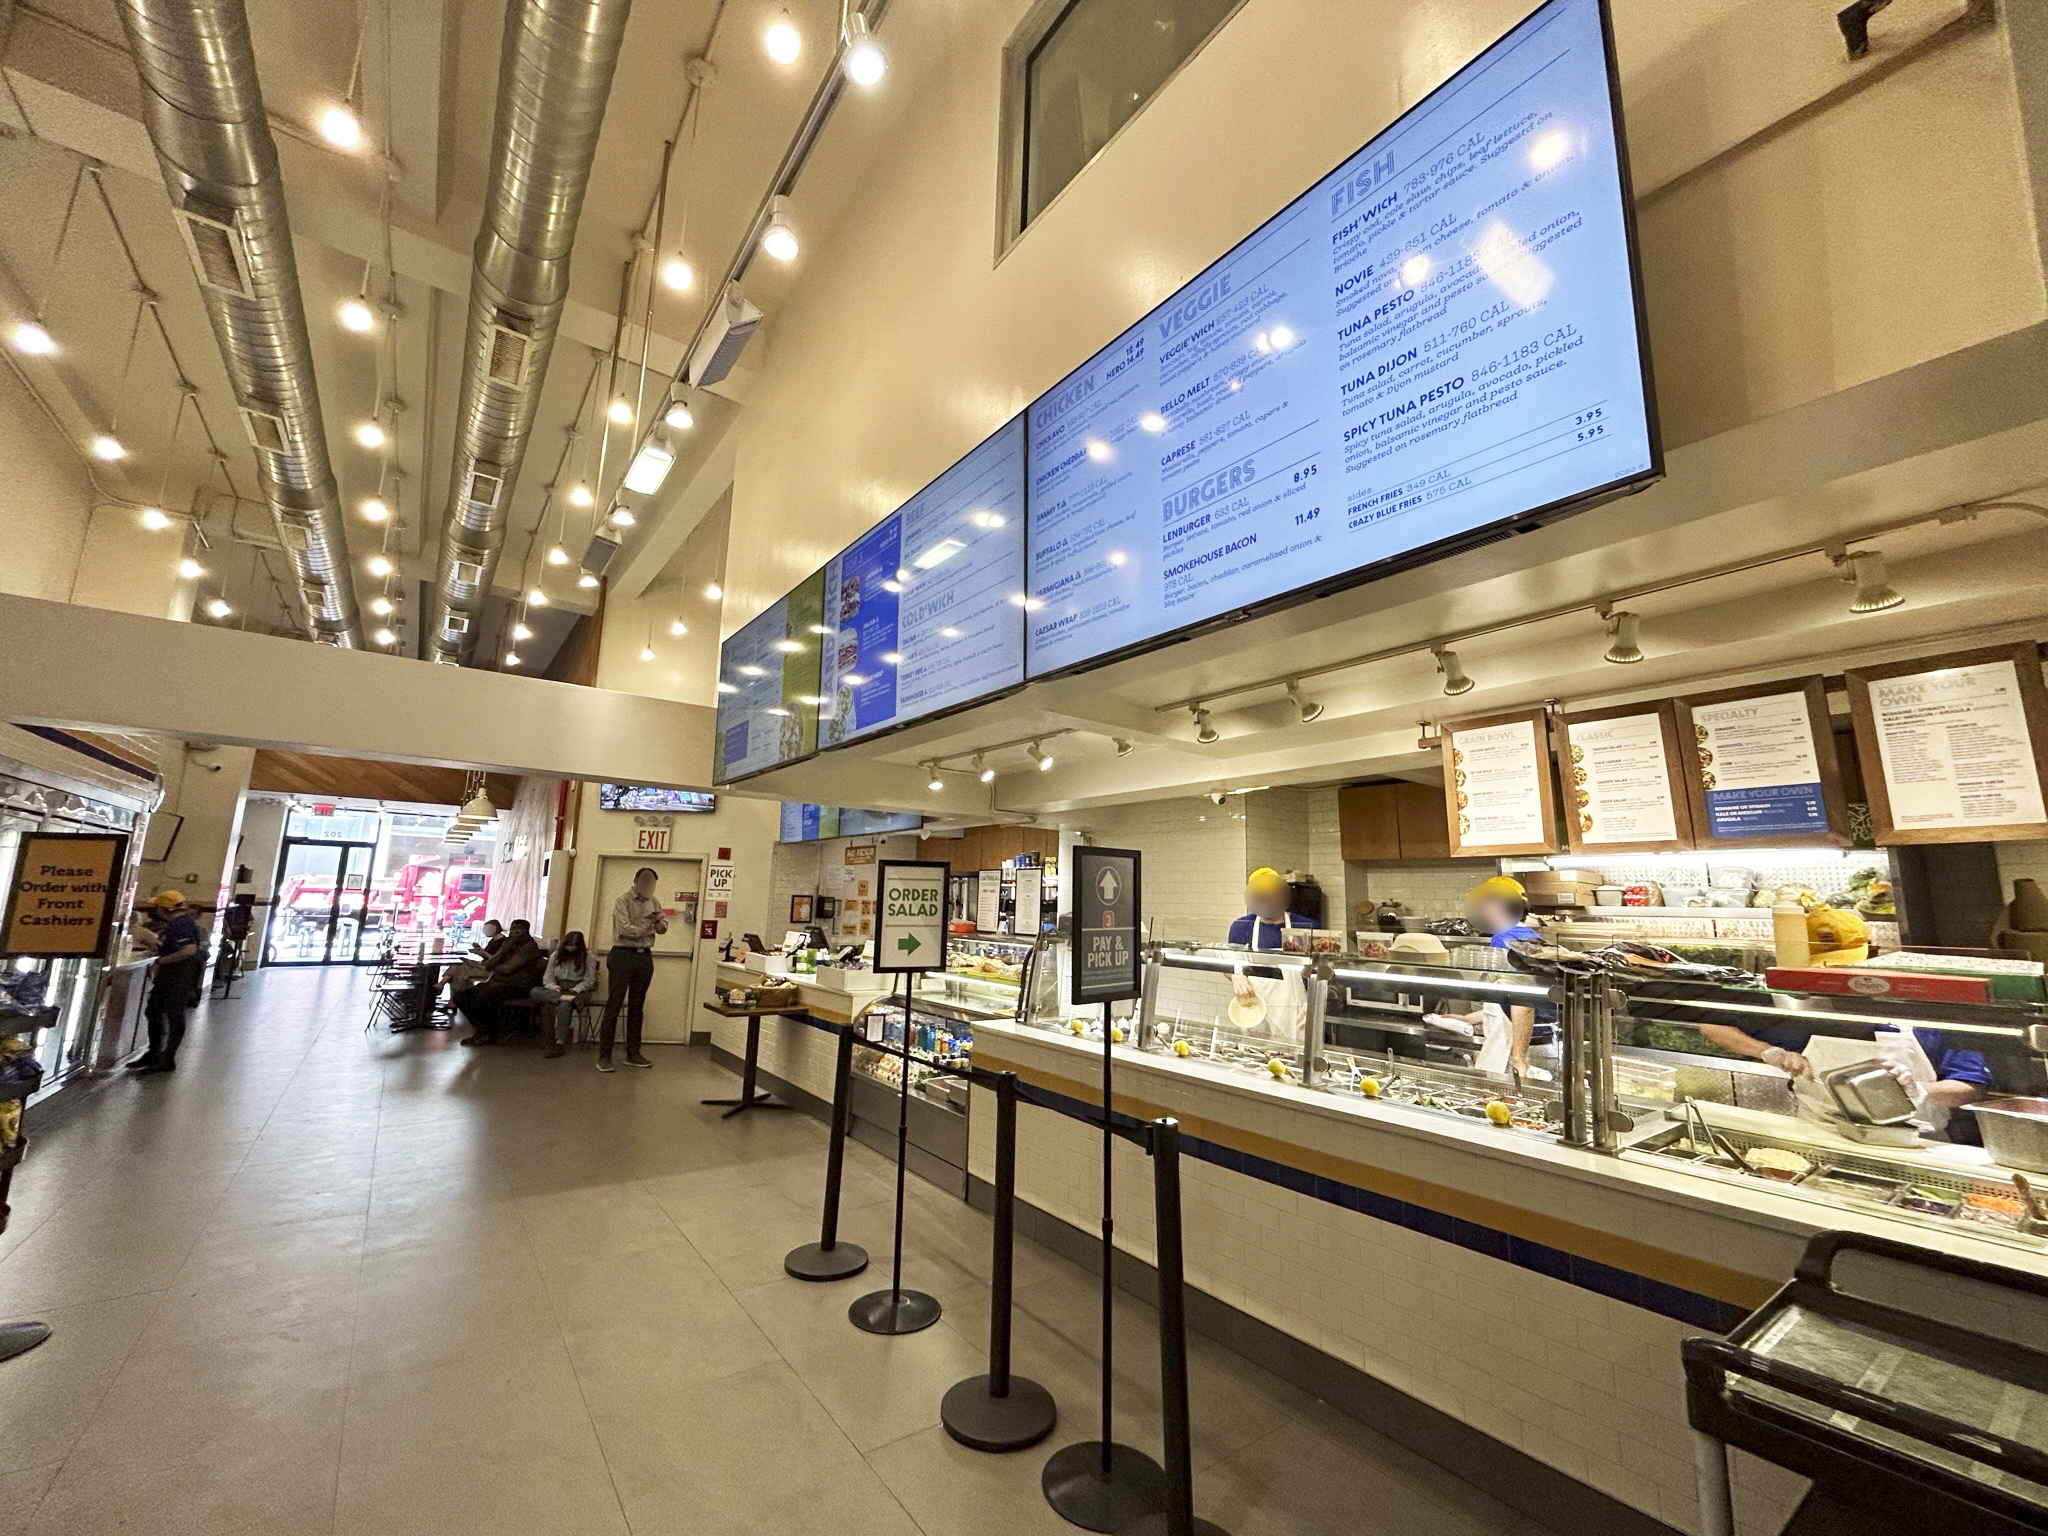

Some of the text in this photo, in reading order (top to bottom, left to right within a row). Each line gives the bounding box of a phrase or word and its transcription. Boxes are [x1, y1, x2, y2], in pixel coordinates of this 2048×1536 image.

[1331, 150, 1395, 217] FISH
[1332, 132, 1485, 244] FISH'WICH 783-976 CAL
[1368, 219, 1396, 242] pickle
[1398, 211, 1407, 221] &
[1409, 188, 1441, 213] tartar
[1480, 122, 1534, 164] Suggestd
[1536, 111, 1553, 126] on
[1332, 232, 1361, 255] Crispy
[1384, 203, 1404, 220] cole
[1469, 139, 1491, 161] leaf
[1335, 280, 1370, 308] Smoked
[1476, 189, 1518, 219] tomato
[1521, 177, 1532, 191] &
[1335, 265, 1373, 296] NOVIE
[1379, 232, 1427, 267] 429-651
[1430, 213, 1457, 236] CAL
[1334, 248, 1368, 274] Brioche
[1336, 278, 1395, 317] Suggested on
[1339, 217, 1583, 362] balsamic vinegar and pesto Suggested
[1159, 273, 1231, 339] VEGGIE
[1338, 290, 1414, 340] TUNA PESTO
[1338, 335, 1361, 352] Tuna
[1339, 306, 1447, 371] on rosemary flatbread
[1341, 301, 1510, 395] TUNA DIJON 511-760 CAL
[1035, 375, 1095, 430] CHICKEN
[1106, 360, 1126, 381] HERO
[1187, 377, 1210, 398] MELT
[1341, 391, 1365, 407] Tuna
[1342, 352, 1459, 417] tomato & Dijon mustard
[1344, 324, 1577, 442] SPICY TUNA PESTO 846-1183 CAL
[1344, 438, 1369, 454] Spicy
[1370, 427, 1393, 441] tuna
[1535, 335, 1583, 368] pickled
[1375, 425, 1420, 450] balsamic
[1422, 405, 1463, 428] vinegar
[1465, 392, 1487, 409] and
[1490, 378, 1523, 401] pesto
[1345, 391, 1517, 474] Suggested on rosemary flatbread
[1161, 440, 1195, 466] CAPRESE
[1348, 408, 1602, 515] FRENCH FRIES 349 CAL 3.95
[1163, 459, 1256, 523] BURGERS
[1348, 424, 1604, 529] CRAZY BLUE FRIES 575 CAL 5.95
[1163, 464, 1317, 543] LENBURGER CAL 8.95
[1164, 507, 1320, 579] SMOKEHOUSE BACON 11.49
[1879, 683, 1928, 698] MAKE
[1879, 694, 1923, 707] OWN
[1701, 707, 1758, 723] SPECIALTY
[1488, 731, 1516, 742] BOWL
[1576, 730, 1614, 742] CLASSIC
[1713, 785, 1813, 801] MAKE YOUR OWN
[637, 830, 667, 850] EXIT
[20, 881, 108, 893] Order with
[40, 865, 94, 877] Please
[710, 869, 733, 878] PICK
[714, 879, 727, 887] UP
[37, 898, 84, 910] Front
[888, 903, 938, 917] SALAD
[889, 888, 938, 902] ORDER
[19, 915, 95, 926] Cashiers
[1105, 914, 1112, 927] 3
[1087, 950, 1129, 968] PICK UP
[1093, 935, 1124, 952] PAY &
